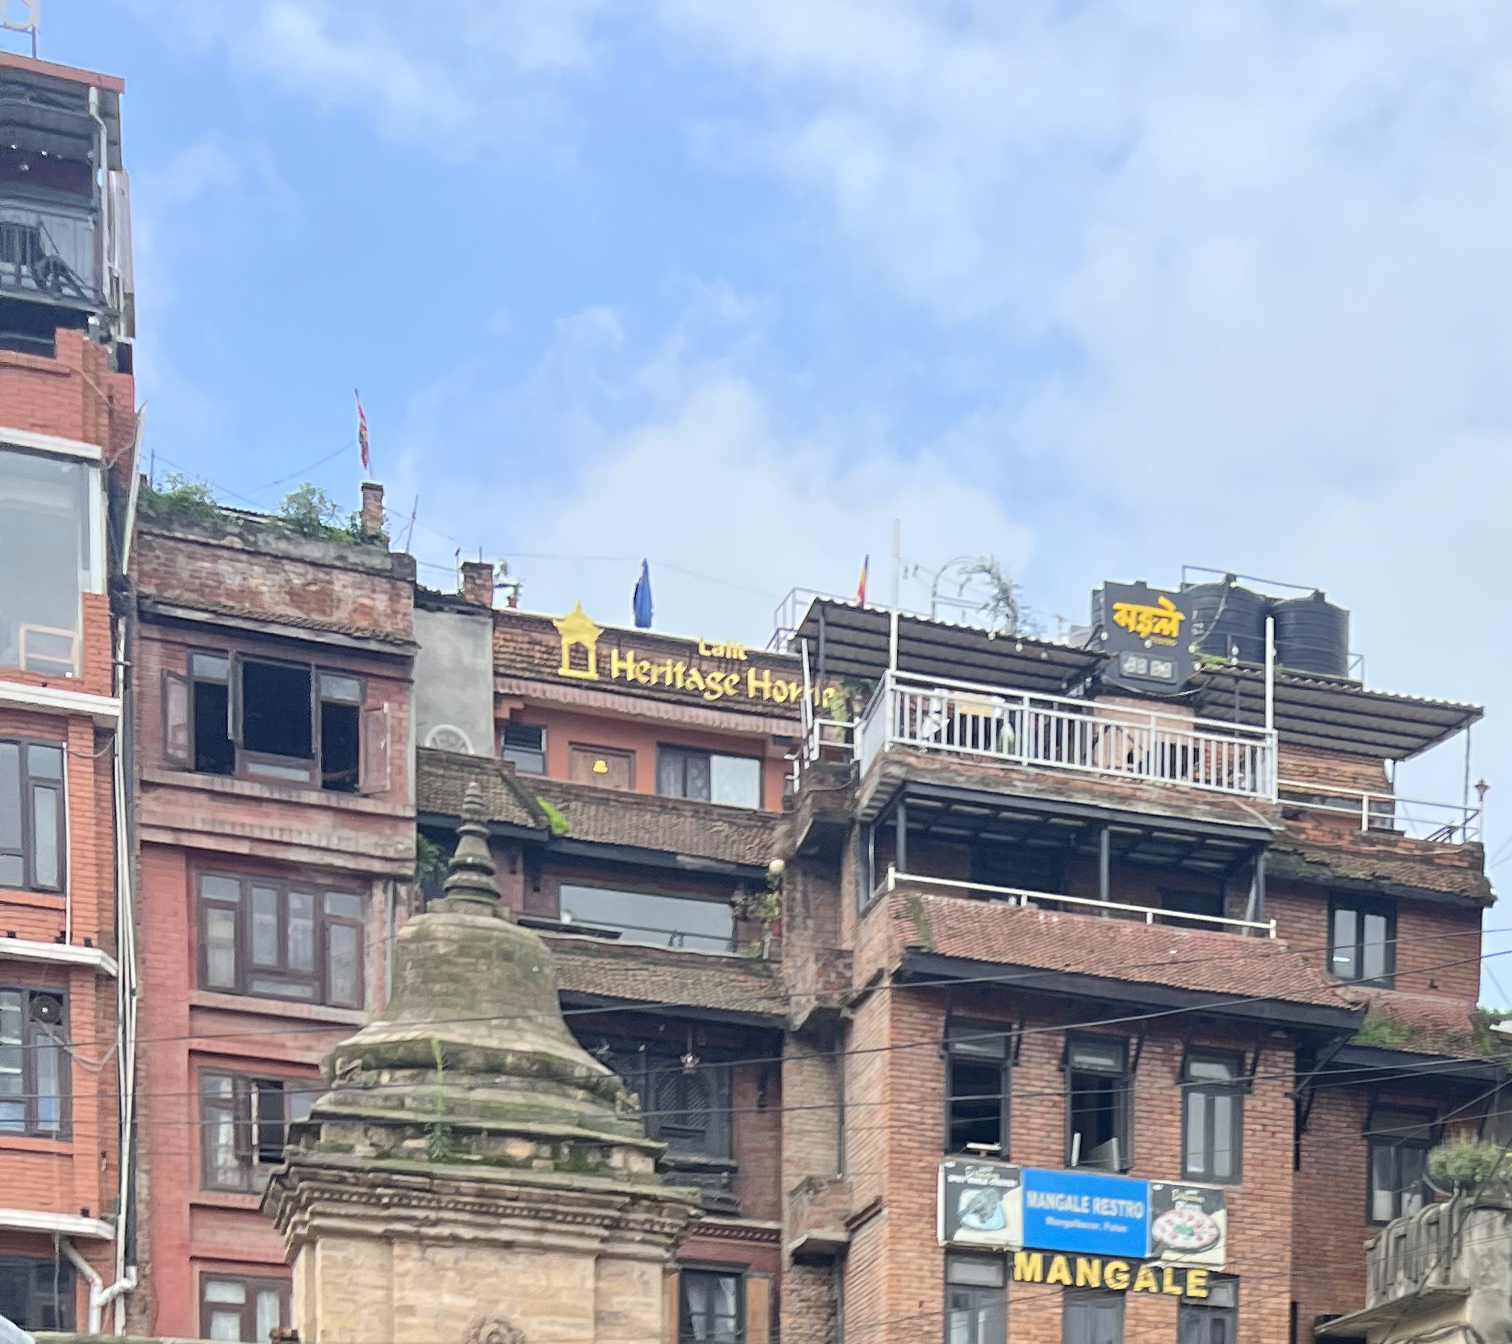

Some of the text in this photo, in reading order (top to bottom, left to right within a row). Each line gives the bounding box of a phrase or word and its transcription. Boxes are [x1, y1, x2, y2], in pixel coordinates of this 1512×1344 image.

[698, 637, 747, 661] Lalit
[610, 648, 741, 700] Heritage
[1026, 1190, 1091, 1214] MANGALE
[1092, 1197, 1145, 1219] RESTRO
[1013, 1250, 1210, 1298] MANGALE
